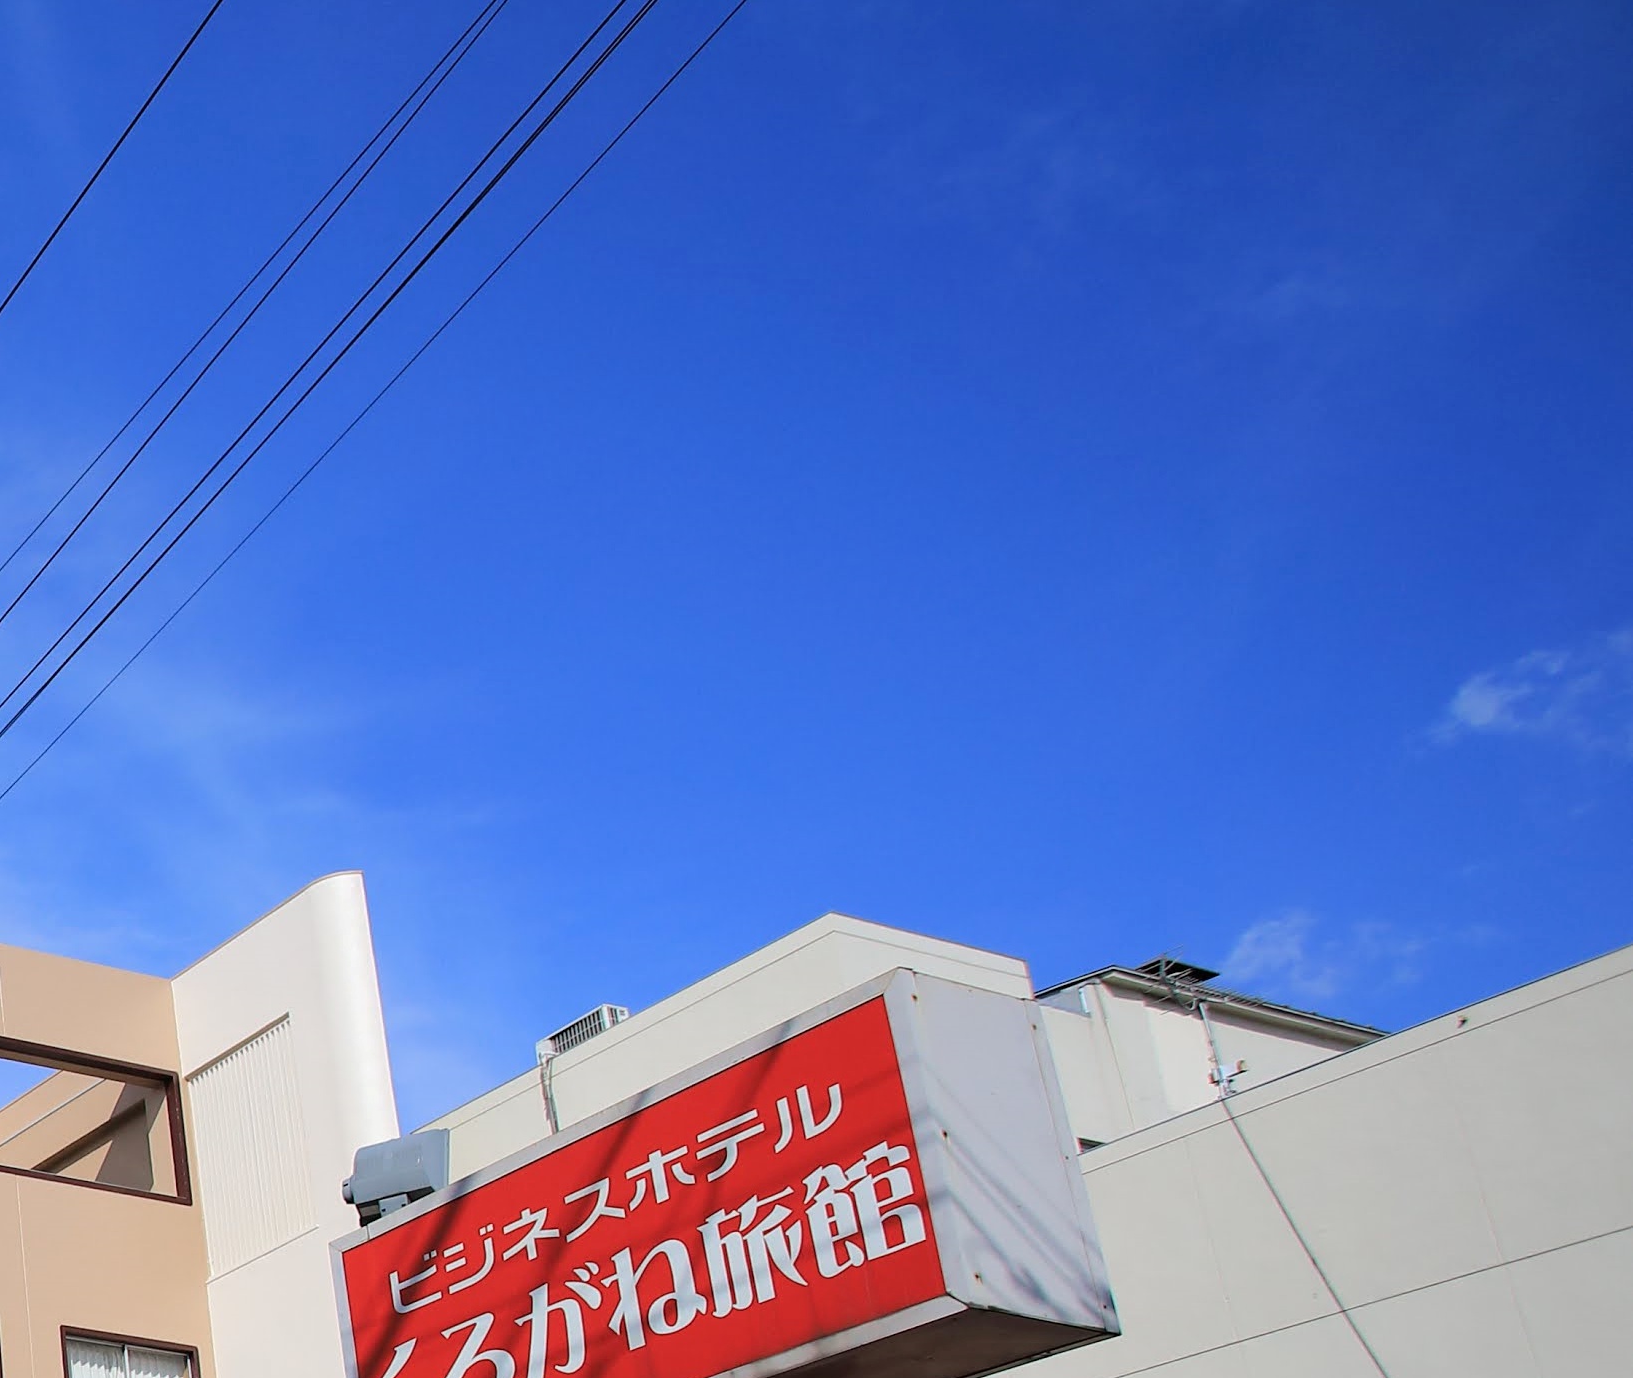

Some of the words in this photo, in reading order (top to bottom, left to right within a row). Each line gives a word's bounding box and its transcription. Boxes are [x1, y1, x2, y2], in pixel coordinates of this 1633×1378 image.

[388, 1082, 843, 1315] ビジネスホテル
